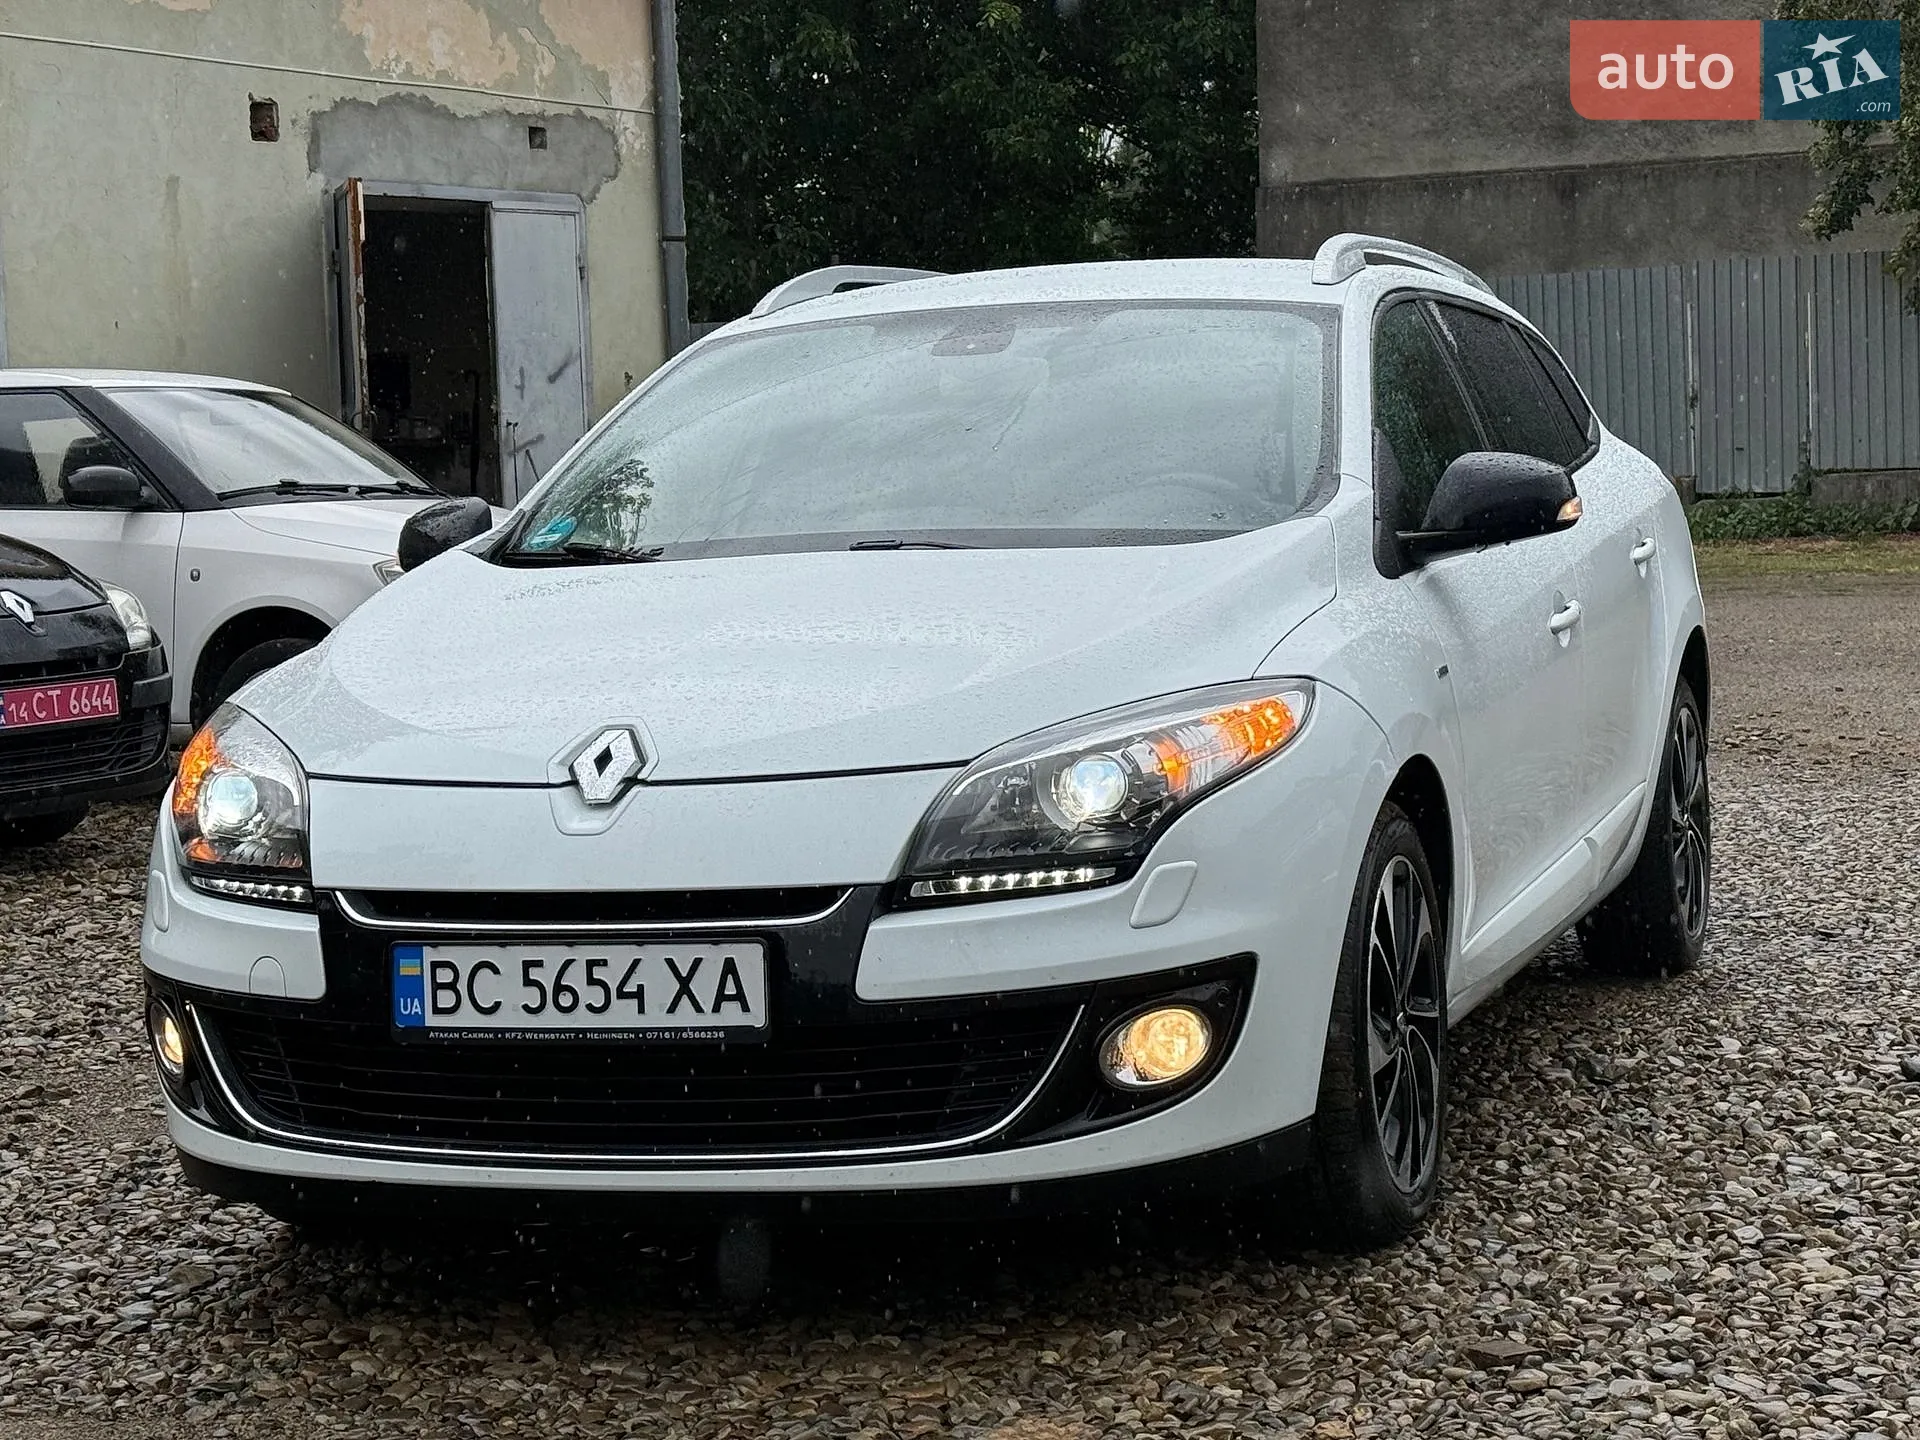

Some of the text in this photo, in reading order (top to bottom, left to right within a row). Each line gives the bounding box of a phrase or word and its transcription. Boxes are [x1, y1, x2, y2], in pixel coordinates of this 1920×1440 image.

[32, 690, 61, 719] CT
[69, 684, 112, 715] 6644
[430, 957, 751, 1016] BC 5654 XA
[400, 998, 422, 1015] UA
